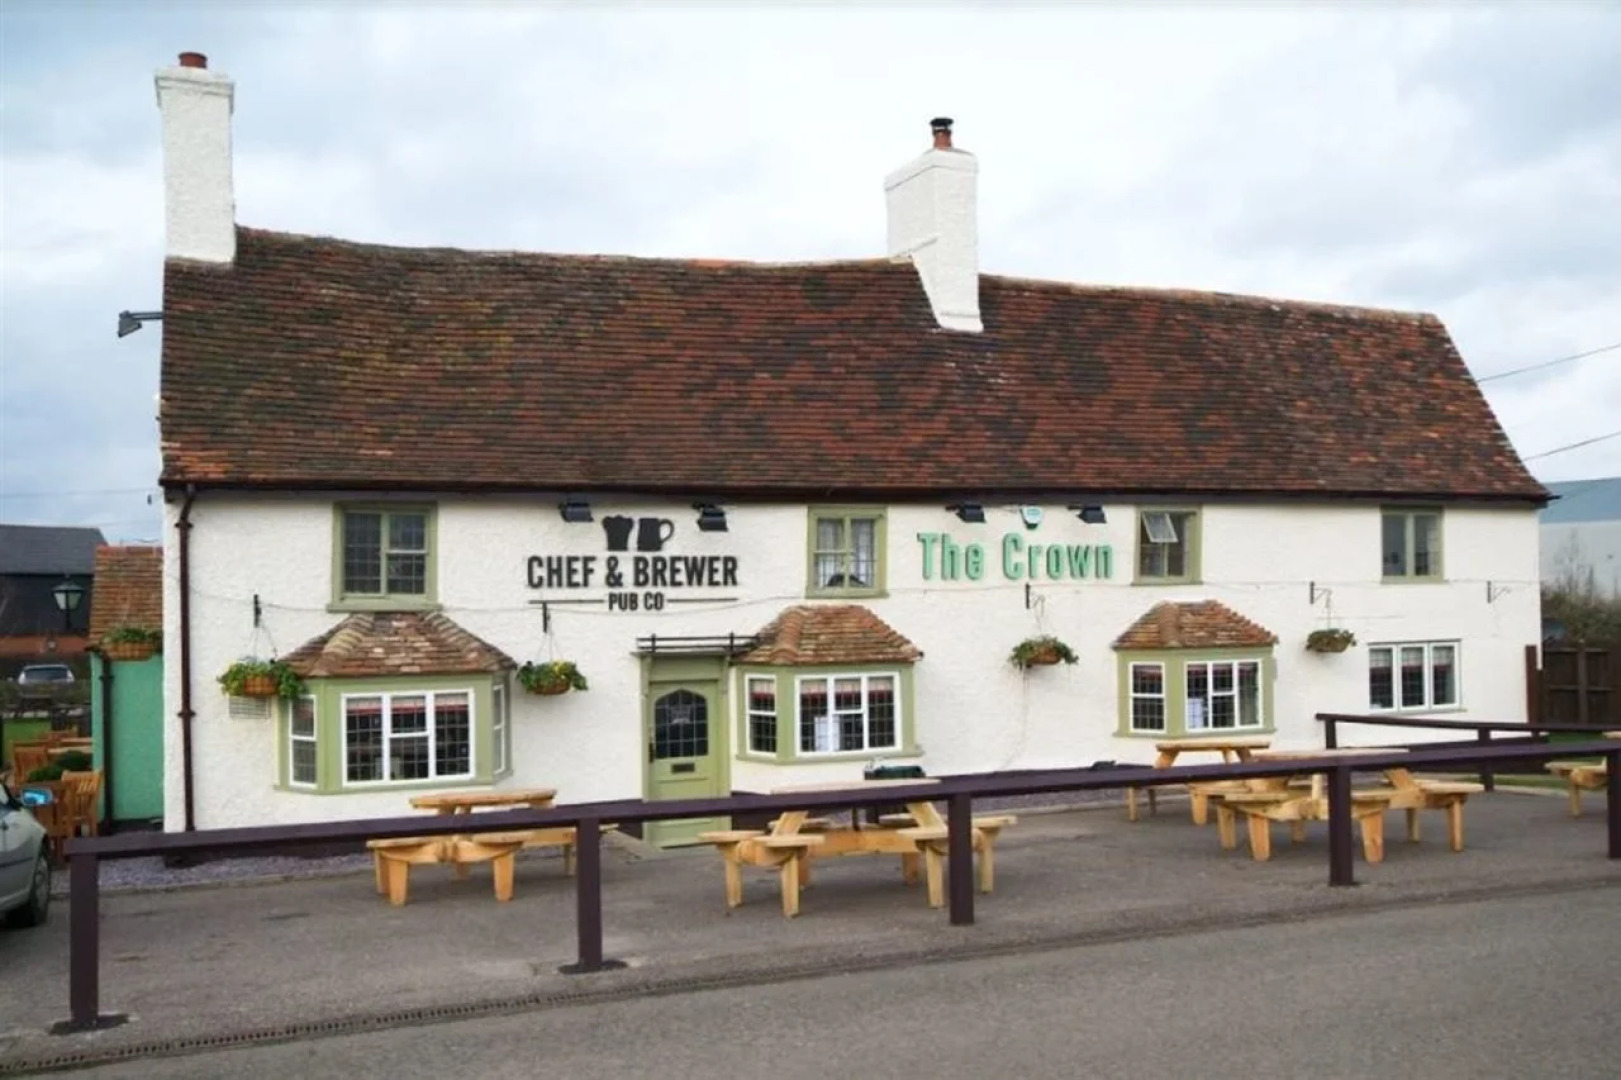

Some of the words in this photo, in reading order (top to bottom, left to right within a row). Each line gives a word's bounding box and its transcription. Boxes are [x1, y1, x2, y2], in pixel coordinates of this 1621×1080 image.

[527, 556, 596, 589] CHEF
[605, 556, 623, 587] &
[633, 556, 738, 587] BREWER
[917, 532, 985, 580] The
[1002, 532, 1114, 580] Crown
[608, 593, 638, 610] PUB
[644, 592, 664, 610] CO
